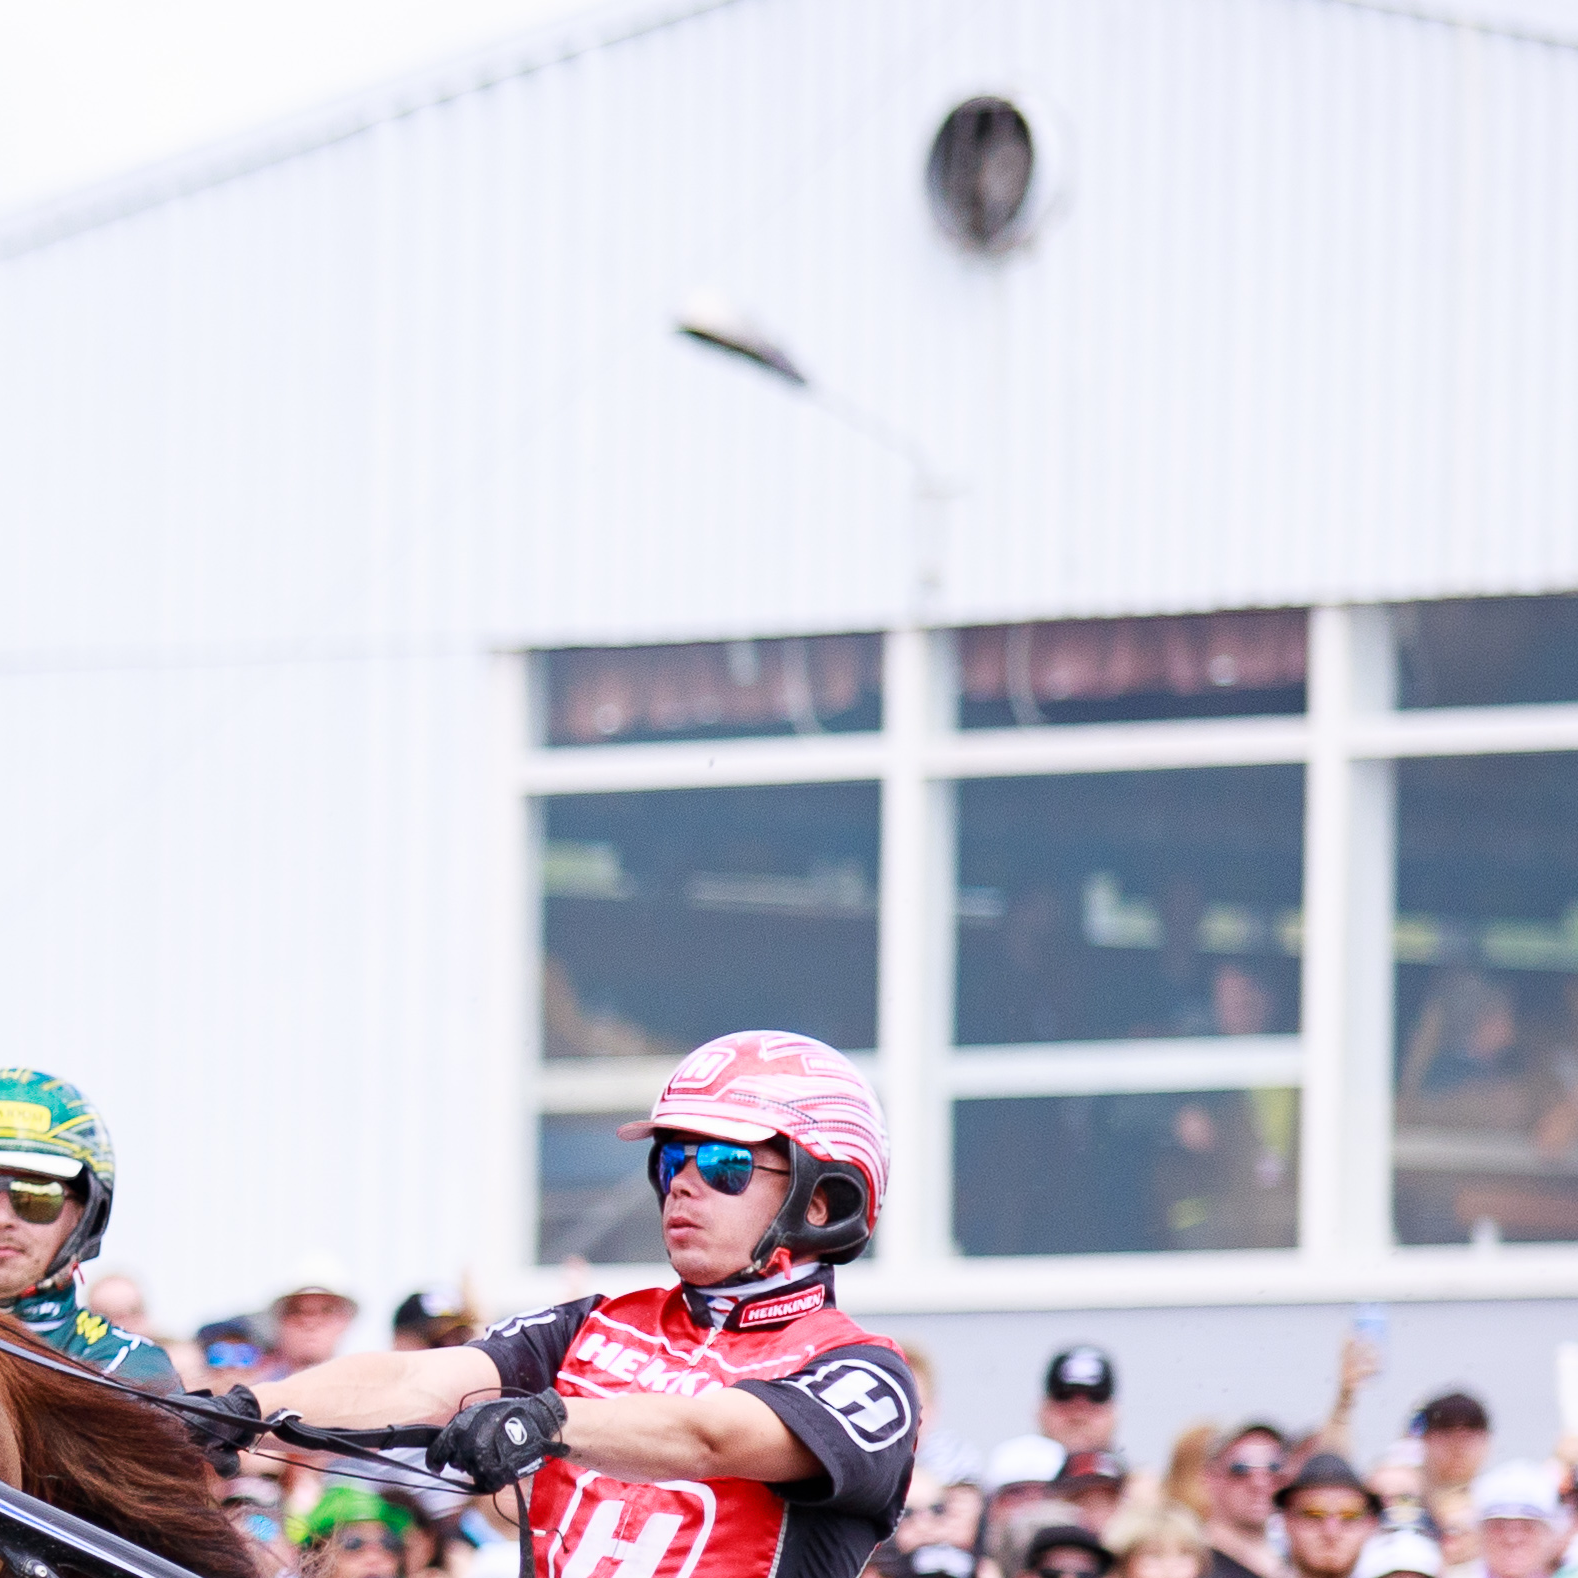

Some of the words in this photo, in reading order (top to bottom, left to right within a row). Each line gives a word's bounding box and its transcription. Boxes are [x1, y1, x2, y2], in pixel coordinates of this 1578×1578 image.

[681, 1053, 725, 1079] H
[748, 1292, 821, 1321] HEIKKINEN
[819, 1369, 899, 1433] H
